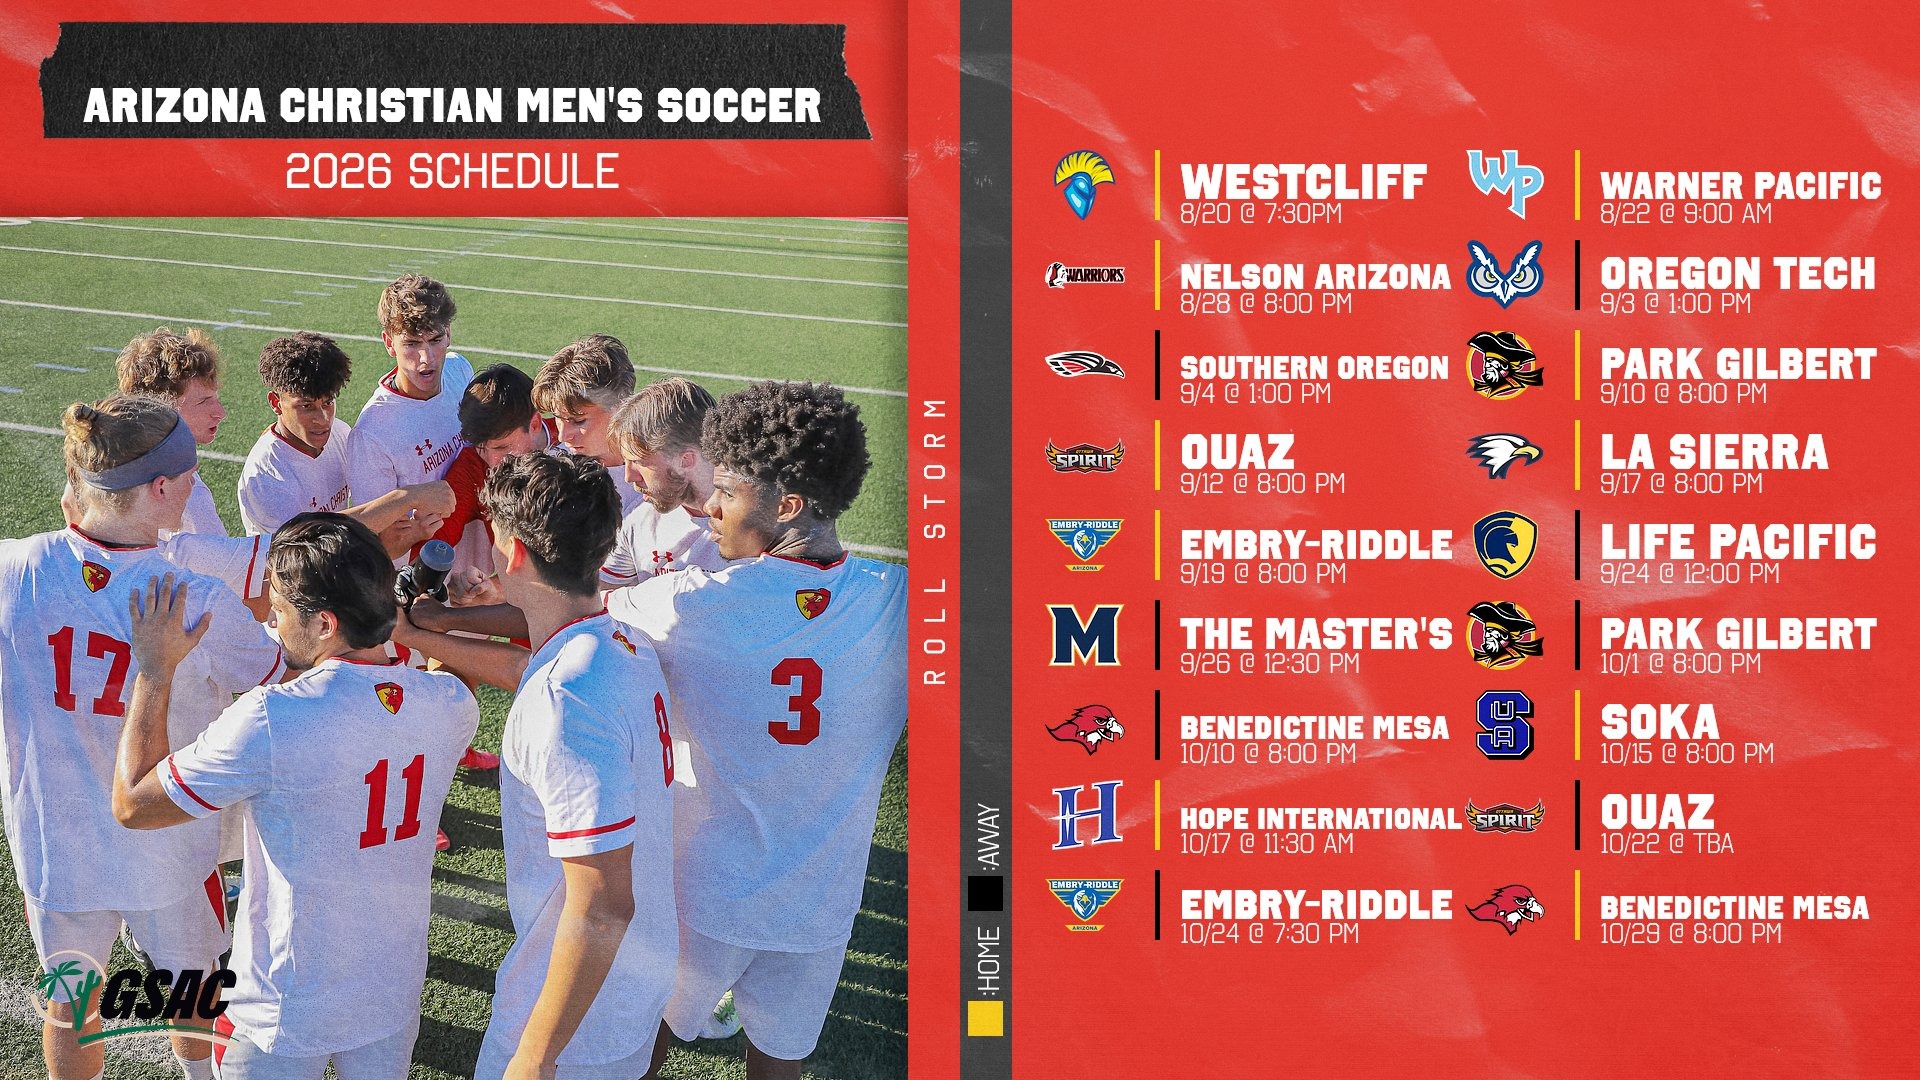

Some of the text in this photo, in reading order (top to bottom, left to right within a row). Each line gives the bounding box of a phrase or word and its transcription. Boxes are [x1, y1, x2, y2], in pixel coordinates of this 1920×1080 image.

[422, 441, 455, 475] ARIZONA
[47, 626, 132, 718] 17
[767, 657, 823, 746] 3
[653, 691, 675, 789] 8
[358, 754, 425, 850] 11
